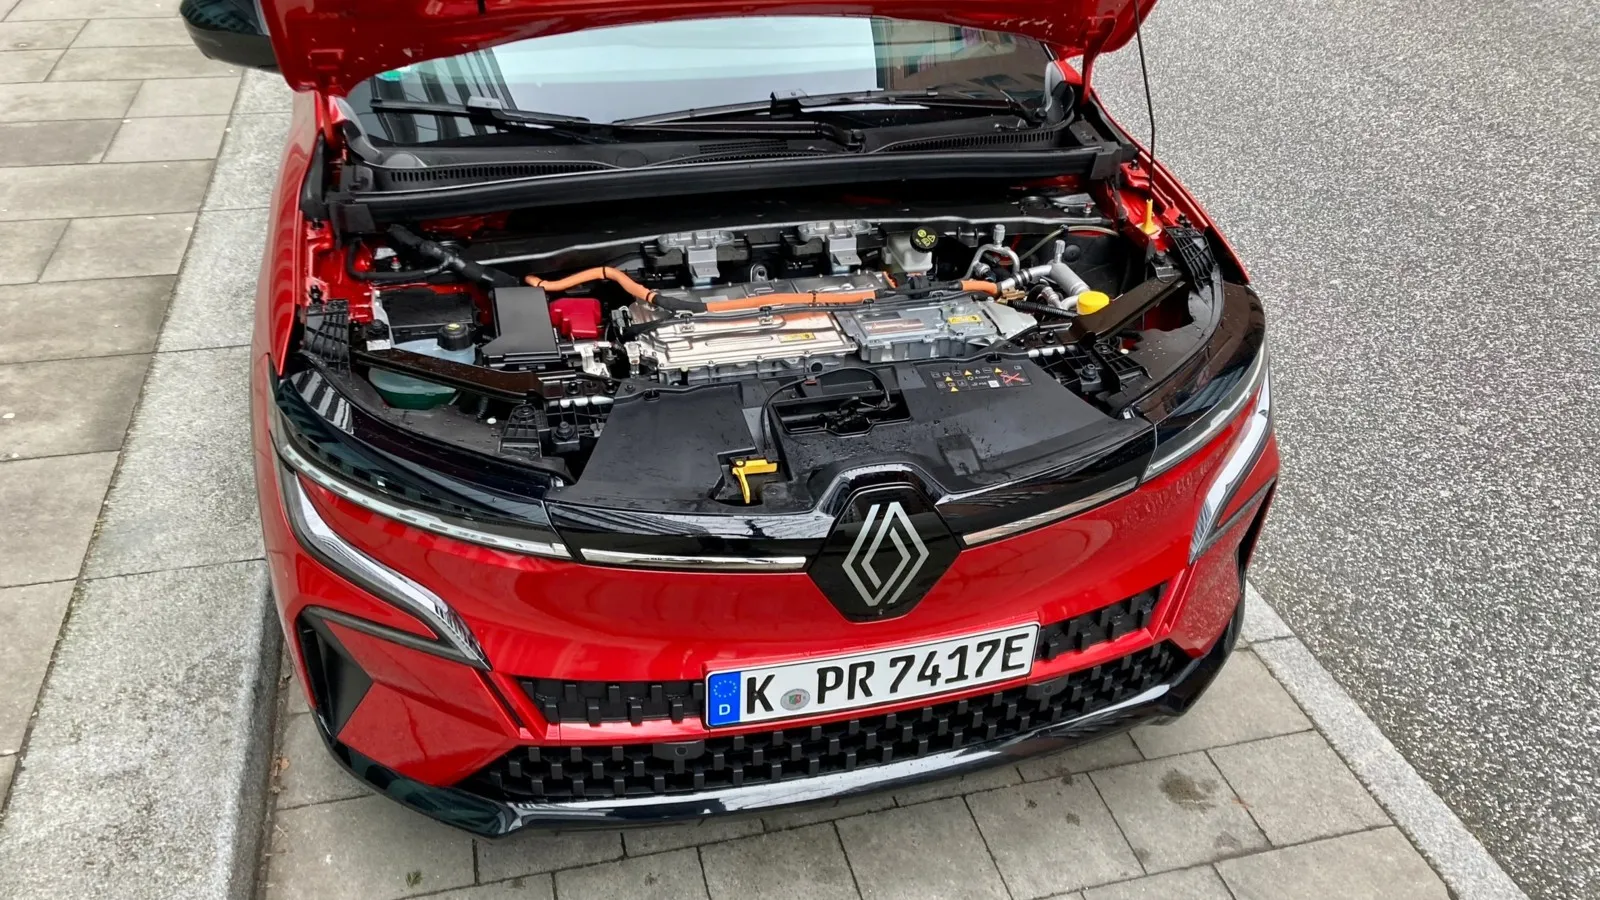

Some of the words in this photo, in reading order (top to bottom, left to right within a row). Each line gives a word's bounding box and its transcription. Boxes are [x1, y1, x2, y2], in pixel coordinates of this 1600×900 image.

[746, 674, 776, 715] K
[816, 660, 876, 705] PR
[888, 632, 1030, 695] 7417E
[719, 703, 731, 716] D
